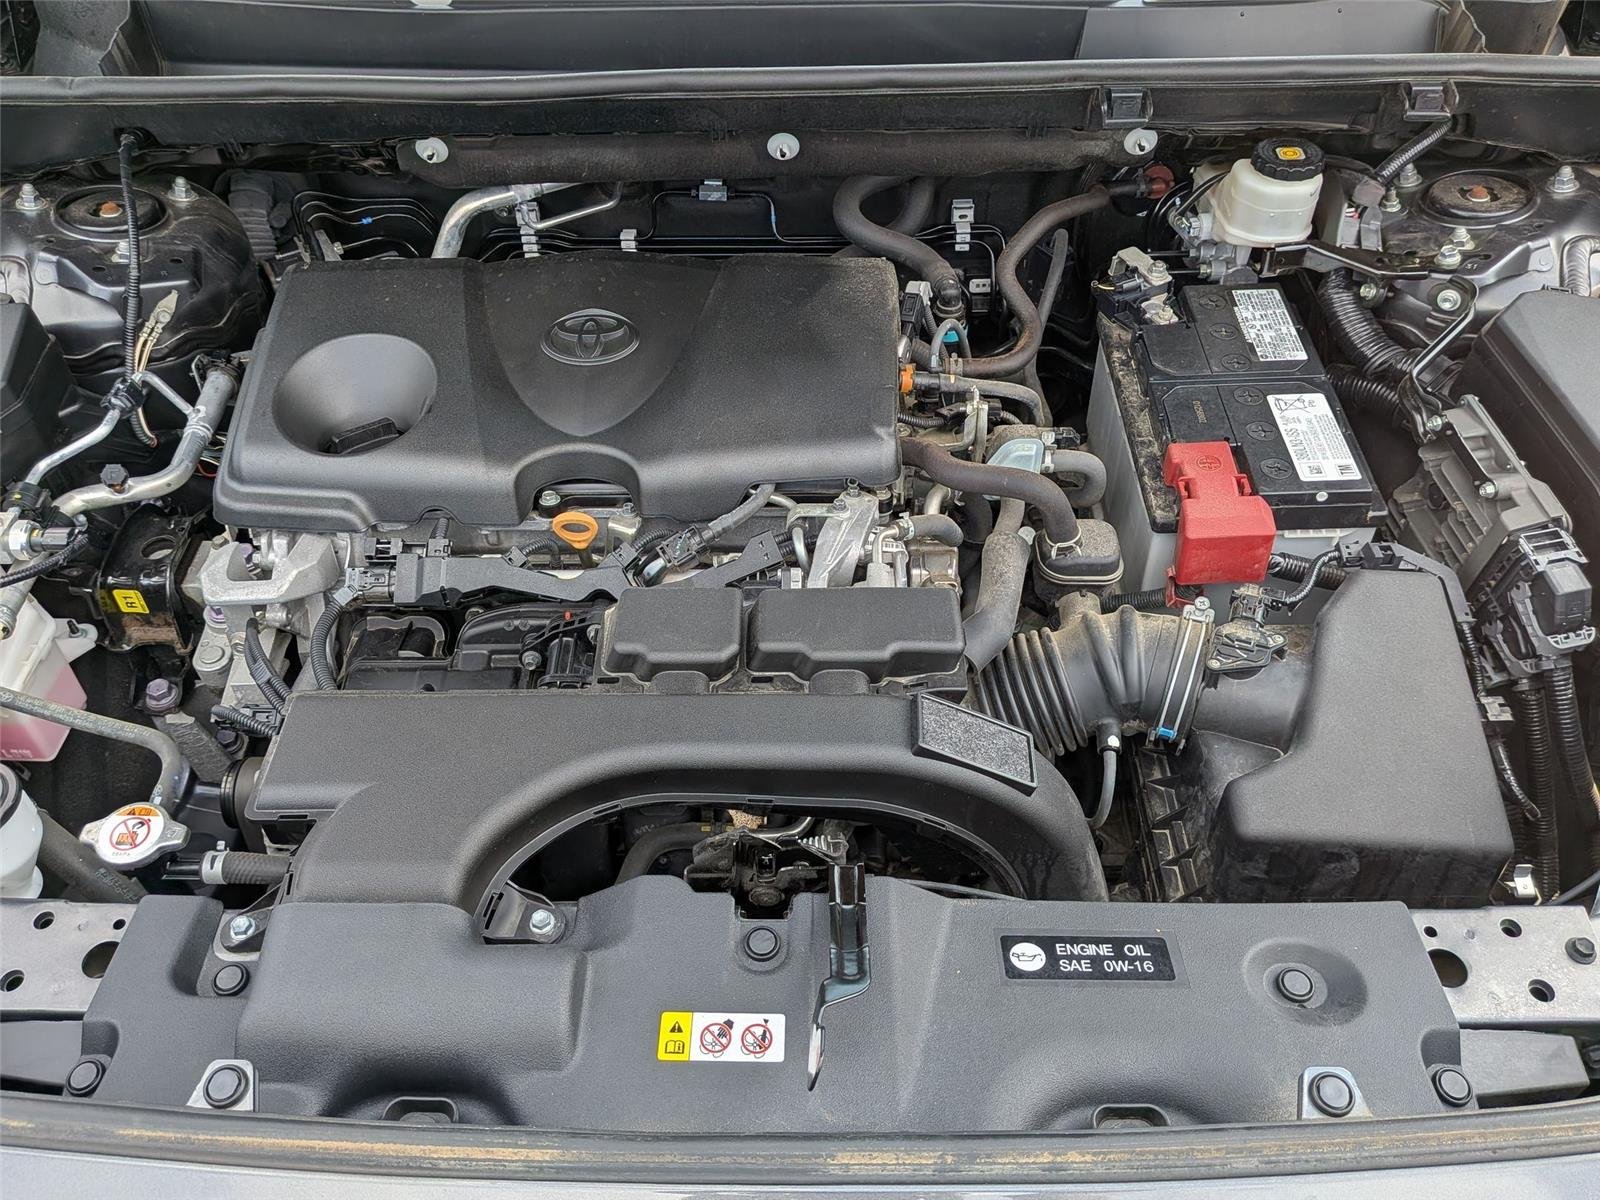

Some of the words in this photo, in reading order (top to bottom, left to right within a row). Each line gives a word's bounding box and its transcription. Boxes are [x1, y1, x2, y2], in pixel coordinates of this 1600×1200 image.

[122, 596, 138, 608] R1
[1055, 943, 1114, 956] ENGINE
[1124, 944, 1151, 957] OIL
[1059, 959, 1093, 972] SAE
[1103, 960, 1155, 973] 0W-16
